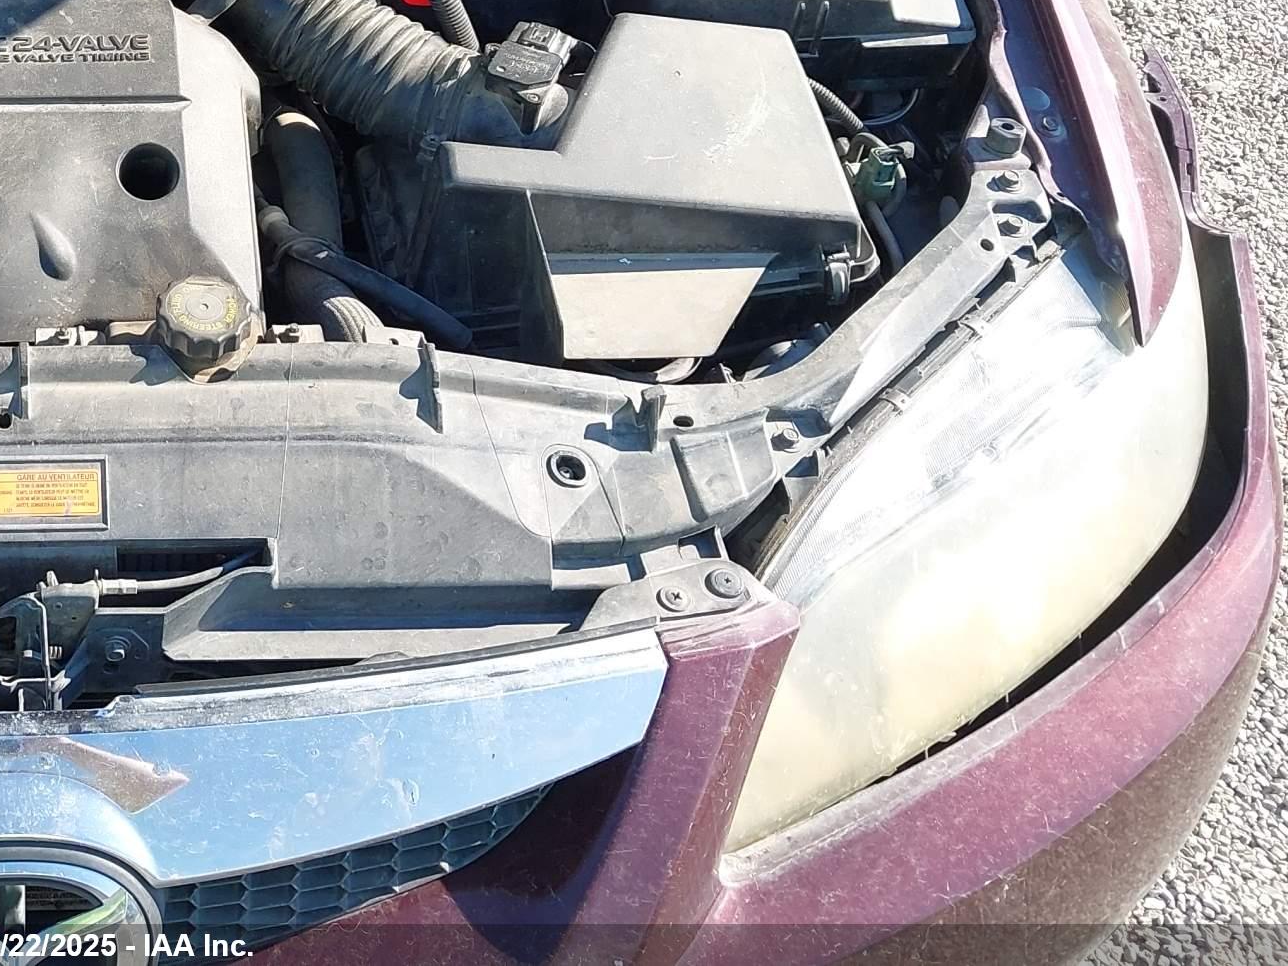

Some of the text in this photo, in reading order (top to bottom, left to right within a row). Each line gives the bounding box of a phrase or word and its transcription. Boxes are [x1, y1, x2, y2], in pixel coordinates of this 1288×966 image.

[12, 34, 150, 52] 24-VALVE
[13, 53, 74, 63] VALVE
[78, 52, 150, 63] TIMING
[179, 314, 223, 331] STEERING
[48, 473, 95, 481] VENTILATEUR
